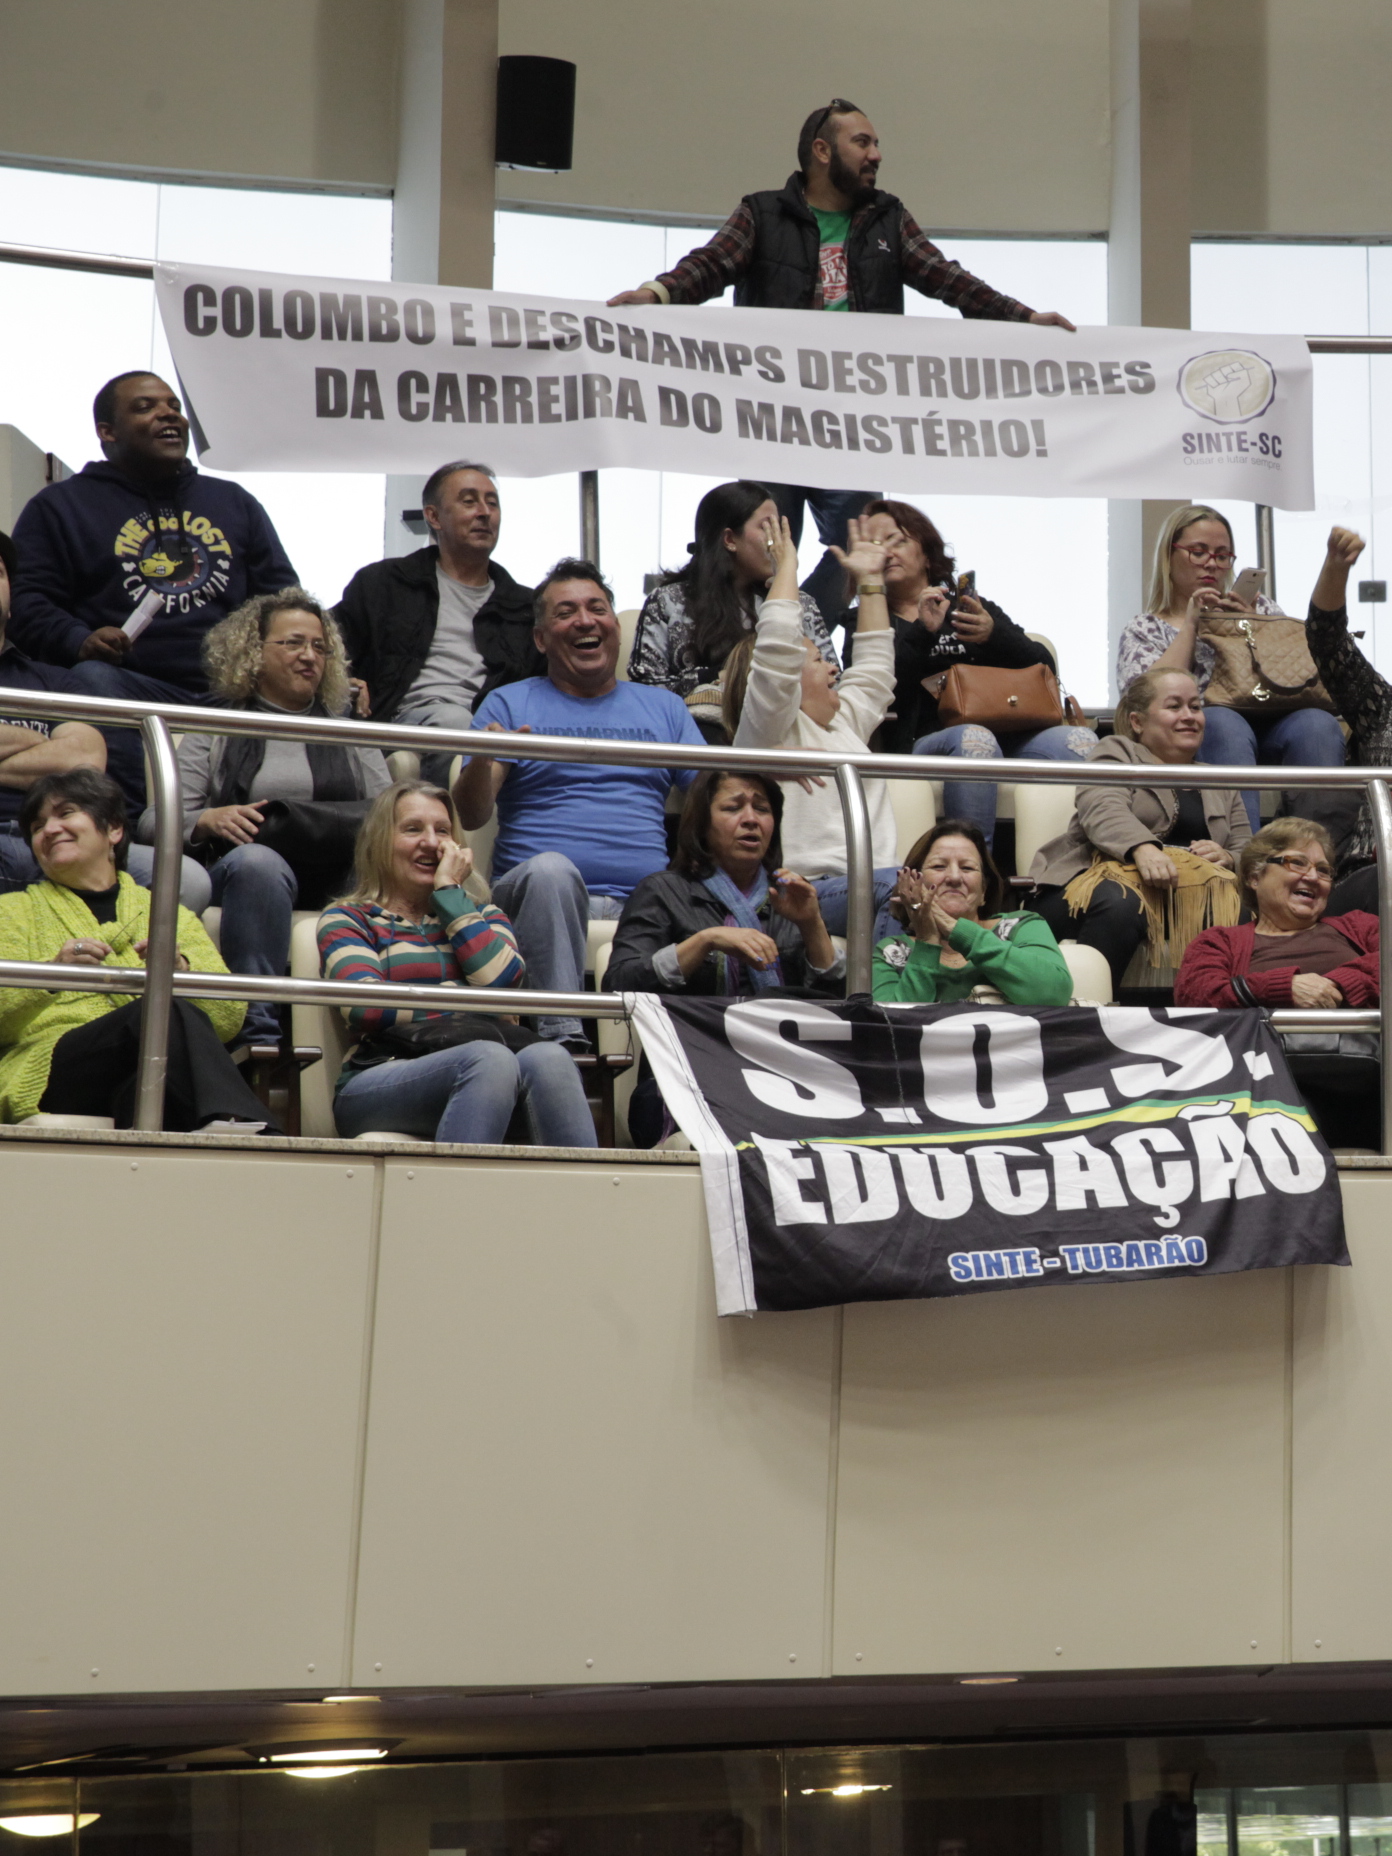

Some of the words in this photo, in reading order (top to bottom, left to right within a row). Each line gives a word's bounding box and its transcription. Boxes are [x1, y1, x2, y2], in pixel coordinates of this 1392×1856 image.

[183, 284, 436, 346] COLOMBO
[451, 302, 476, 347] E
[489, 305, 784, 384] DESCHAMPS
[796, 348, 1156, 400] DESTRUIDORES
[314, 367, 385, 422] DA
[396, 370, 648, 425] CARREIRA
[658, 385, 723, 435] DO
[735, 398, 1049, 459] MAGISTÉRIO!
[1181, 430, 1283, 459] SINTE-SC
[1183, 455, 1215, 466] Ousar
[1226, 454, 1249, 464] lutar
[114, 517, 151, 558] THE
[723, 998, 1275, 1126] S.O.S.
[750, 1098, 1327, 1230] EDUCAÇÃO
[948, 1246, 1042, 1284] SINTE
[1061, 1234, 1209, 1274] TUBARÃO
